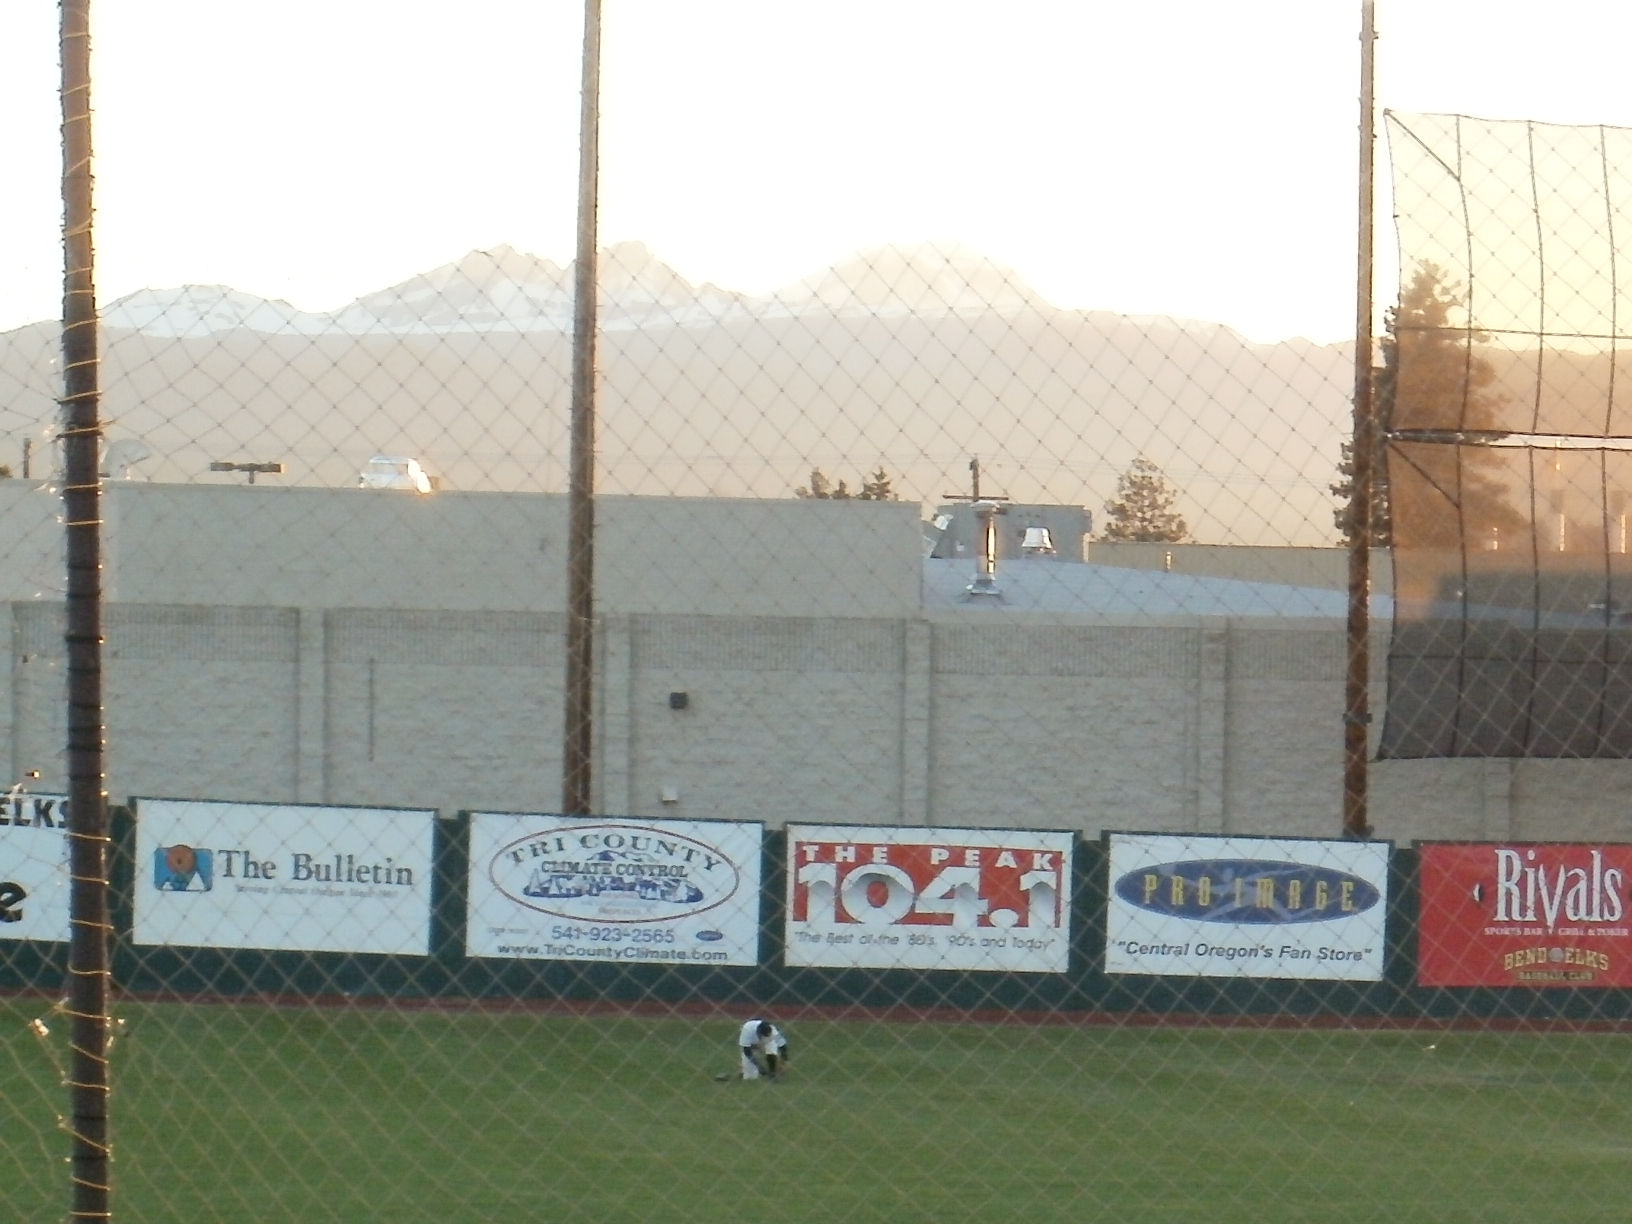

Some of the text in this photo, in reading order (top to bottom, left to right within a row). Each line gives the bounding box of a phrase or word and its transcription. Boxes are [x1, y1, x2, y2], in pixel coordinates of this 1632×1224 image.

[506, 833, 723, 873] TRI COUNTY
[803, 845, 1053, 870] THE PEAK
[217, 850, 413, 886] The Bulletin
[541, 860, 688, 878] CLIMATE CONTROL
[798, 862, 1057, 928] 104.1
[1143, 874, 1355, 912] PRO IMAGE
[1493, 849, 1623, 934] Rivals
[551, 925, 675, 943] 541-923-2565
[1484, 927, 1521, 936] SPORTS
[1117, 940, 1373, 962] "Central Oregon's Fan Store"
[1504, 947, 1609, 971] BEND ELKS
